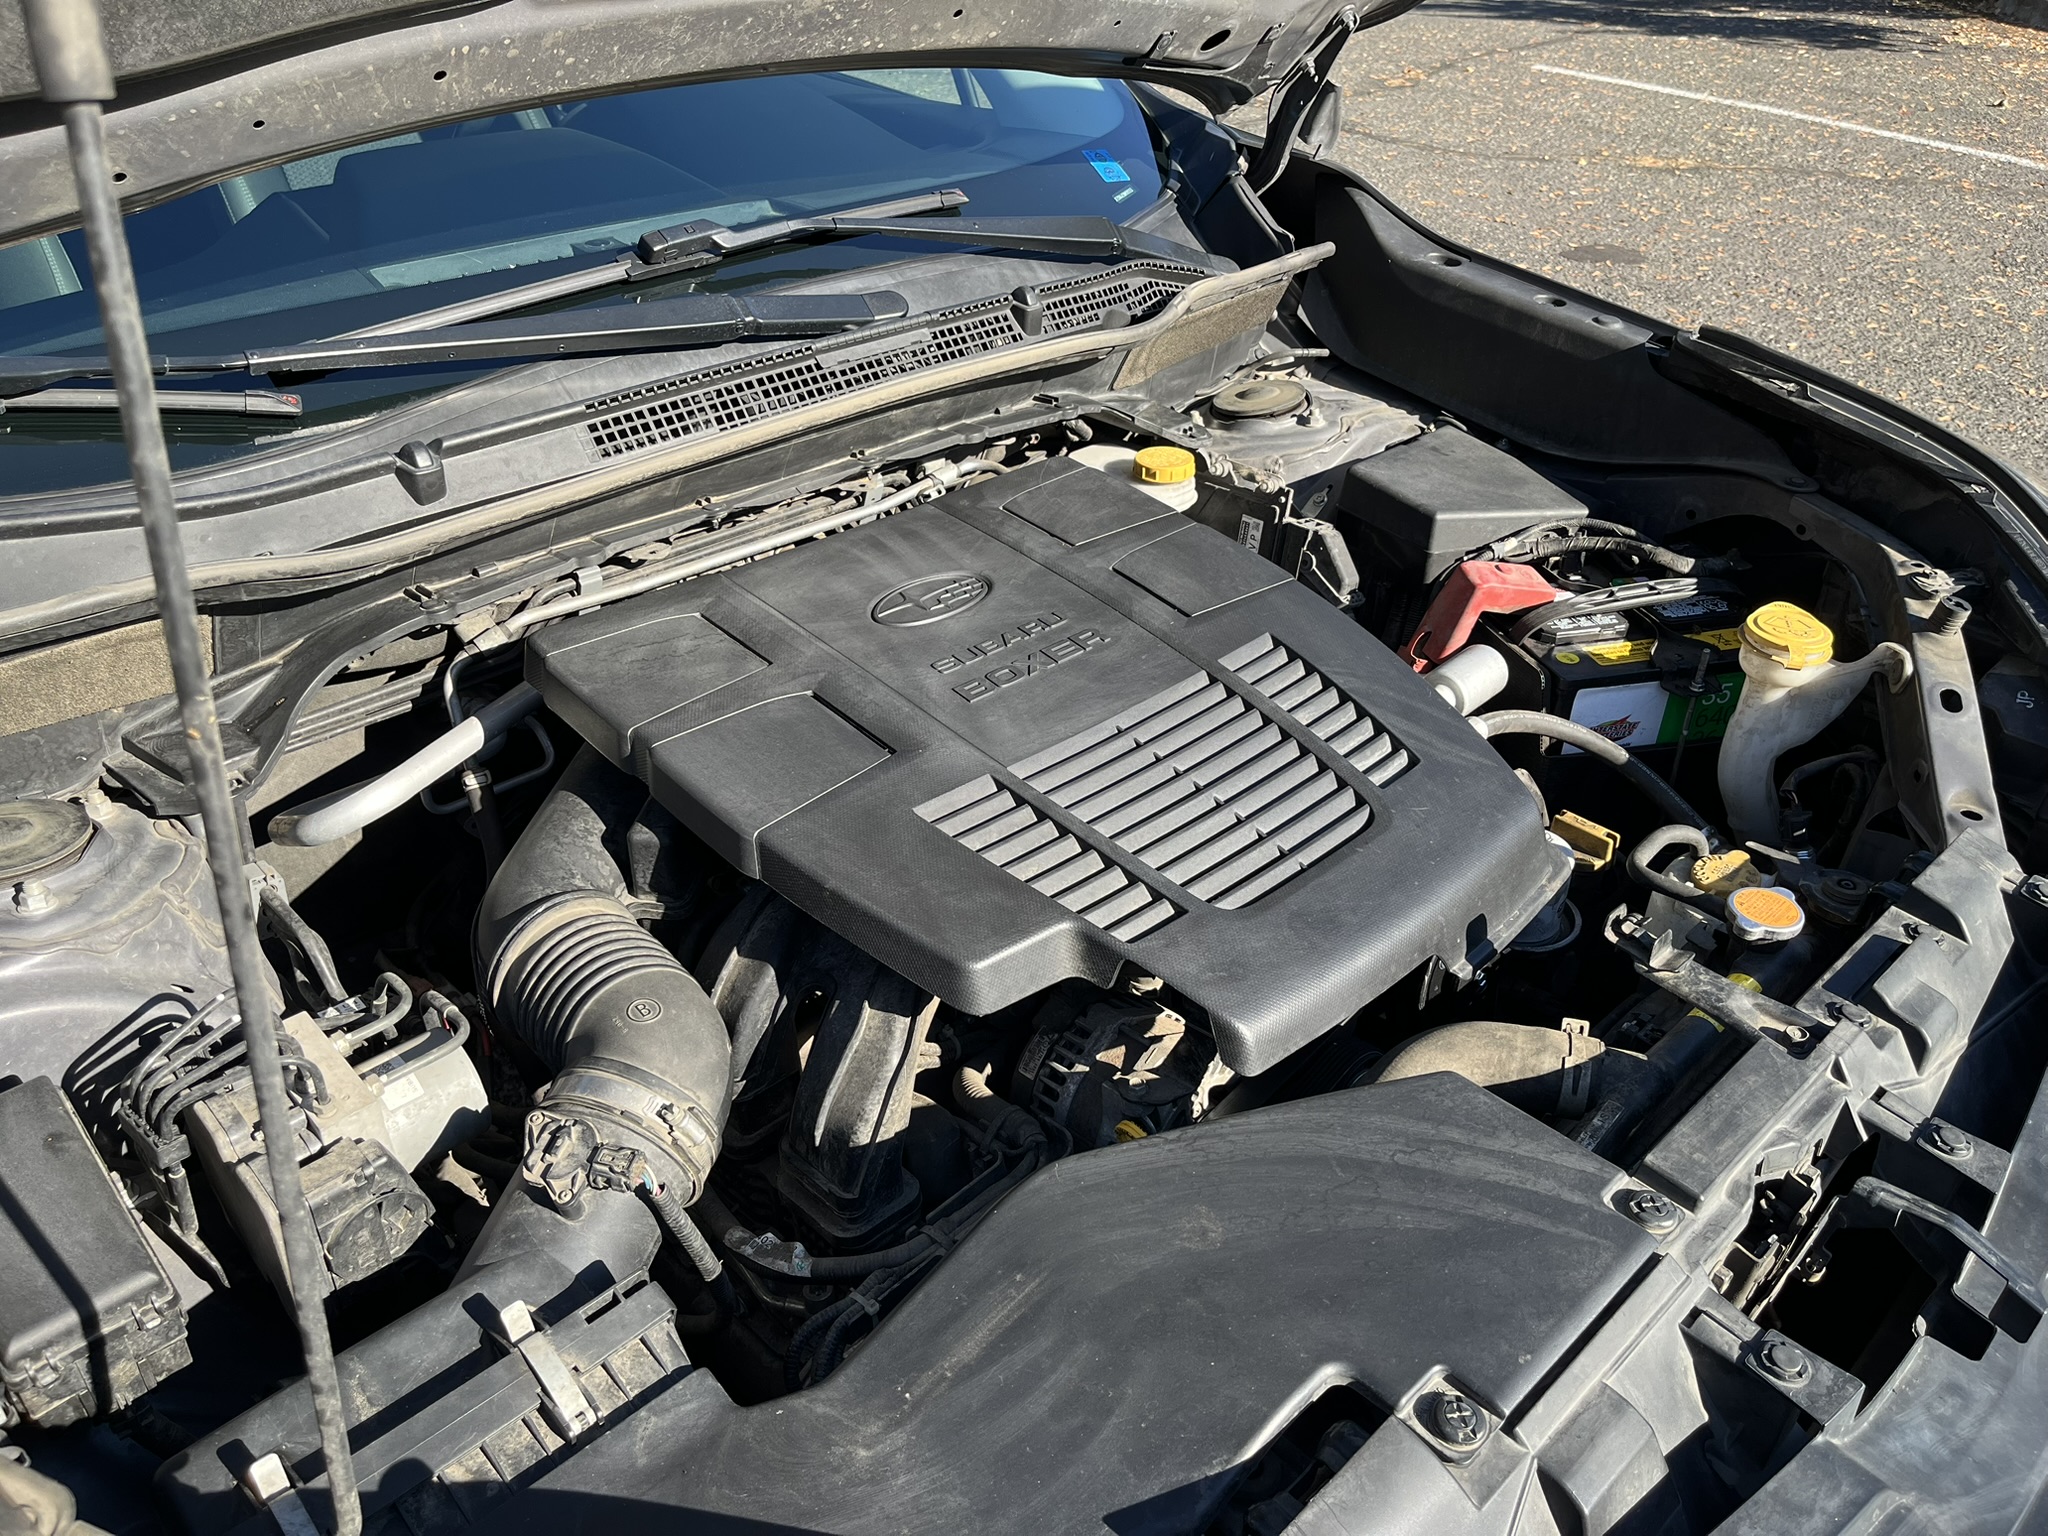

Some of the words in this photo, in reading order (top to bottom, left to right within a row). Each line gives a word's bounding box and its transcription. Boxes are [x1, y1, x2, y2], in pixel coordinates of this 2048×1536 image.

[930, 612, 1068, 674] SUBARU
[951, 628, 1111, 703] BOXER
[634, 1003, 652, 1017] B
